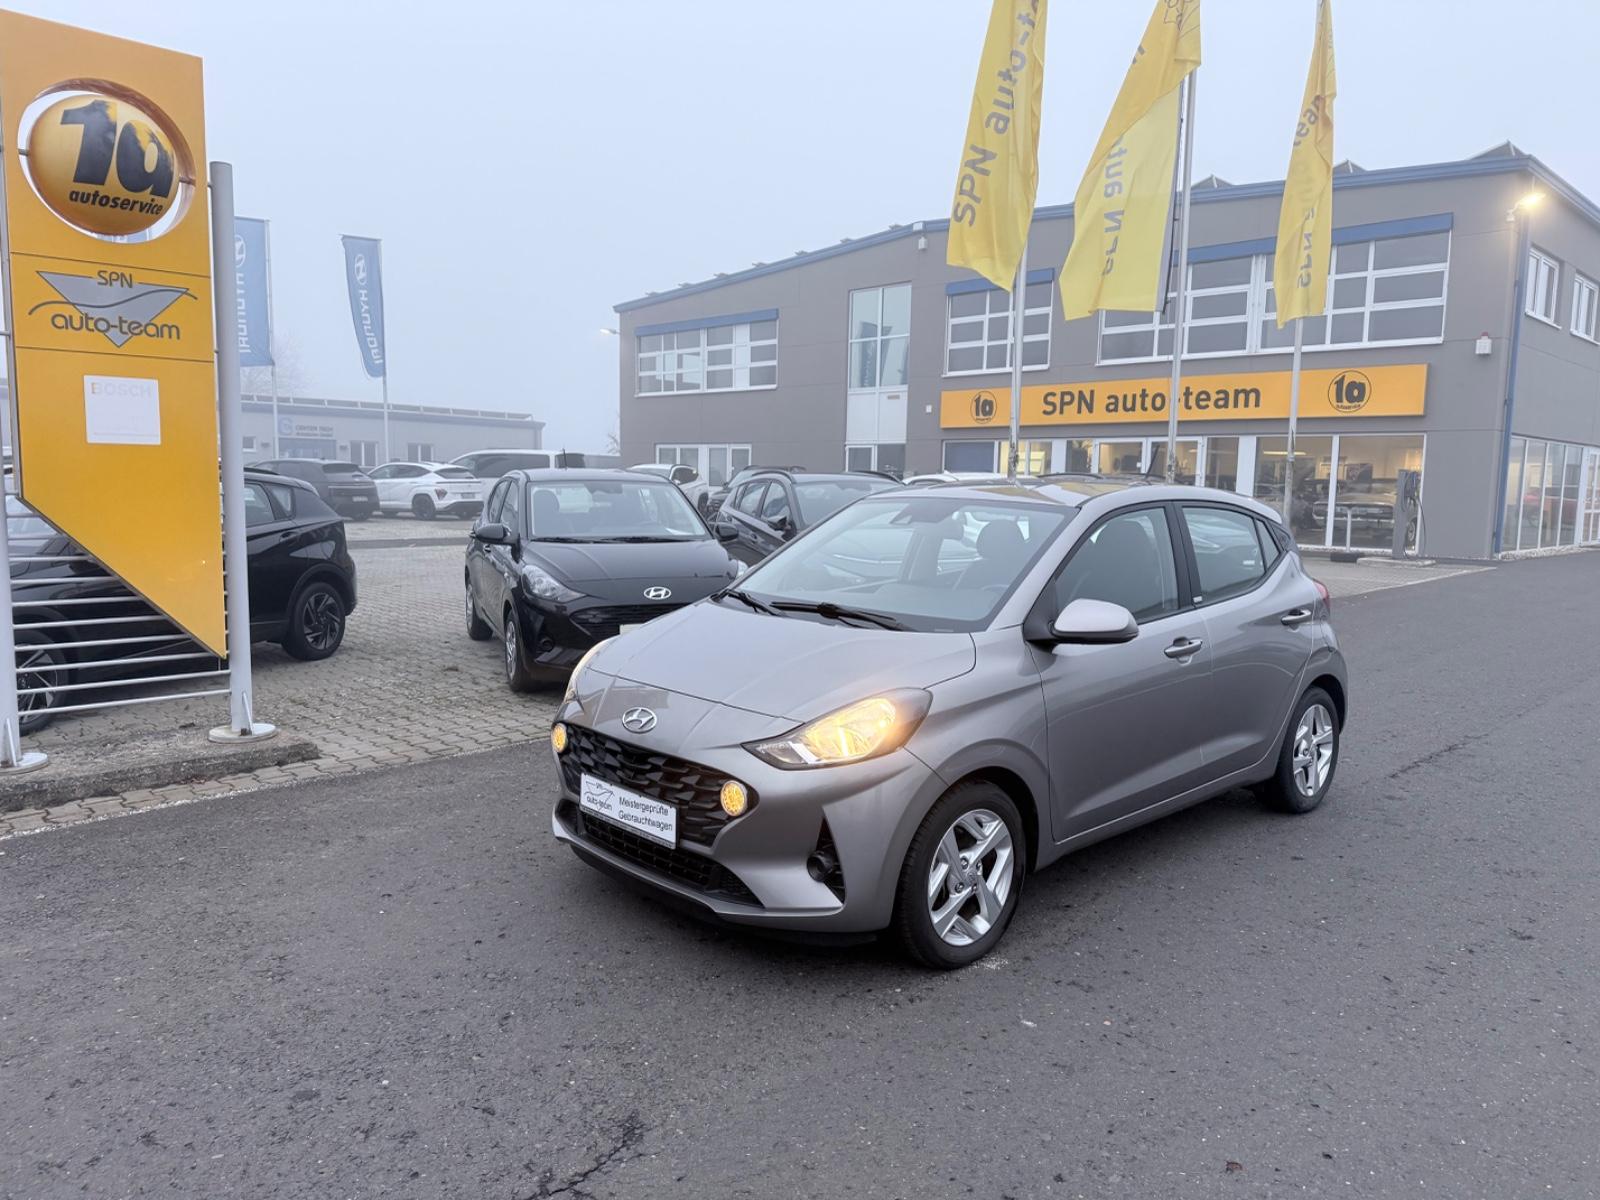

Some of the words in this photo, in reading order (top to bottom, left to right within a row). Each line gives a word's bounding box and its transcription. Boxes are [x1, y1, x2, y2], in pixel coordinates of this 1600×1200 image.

[953, 144, 998, 227] SPN
[985, 0, 1040, 135] auto-t
[60, 99, 174, 199] 1a
[69, 189, 164, 215] autoservice
[97, 270, 133, 289] SPN
[51, 312, 180, 340] auto-team
[91, 382, 153, 398] BOSCH
[1042, 389, 1095, 416] SPN
[1105, 385, 1261, 413] autoteam
[1334, 374, 1367, 403] 1a
[618, 810, 673, 832] Gebrauchtwagen
